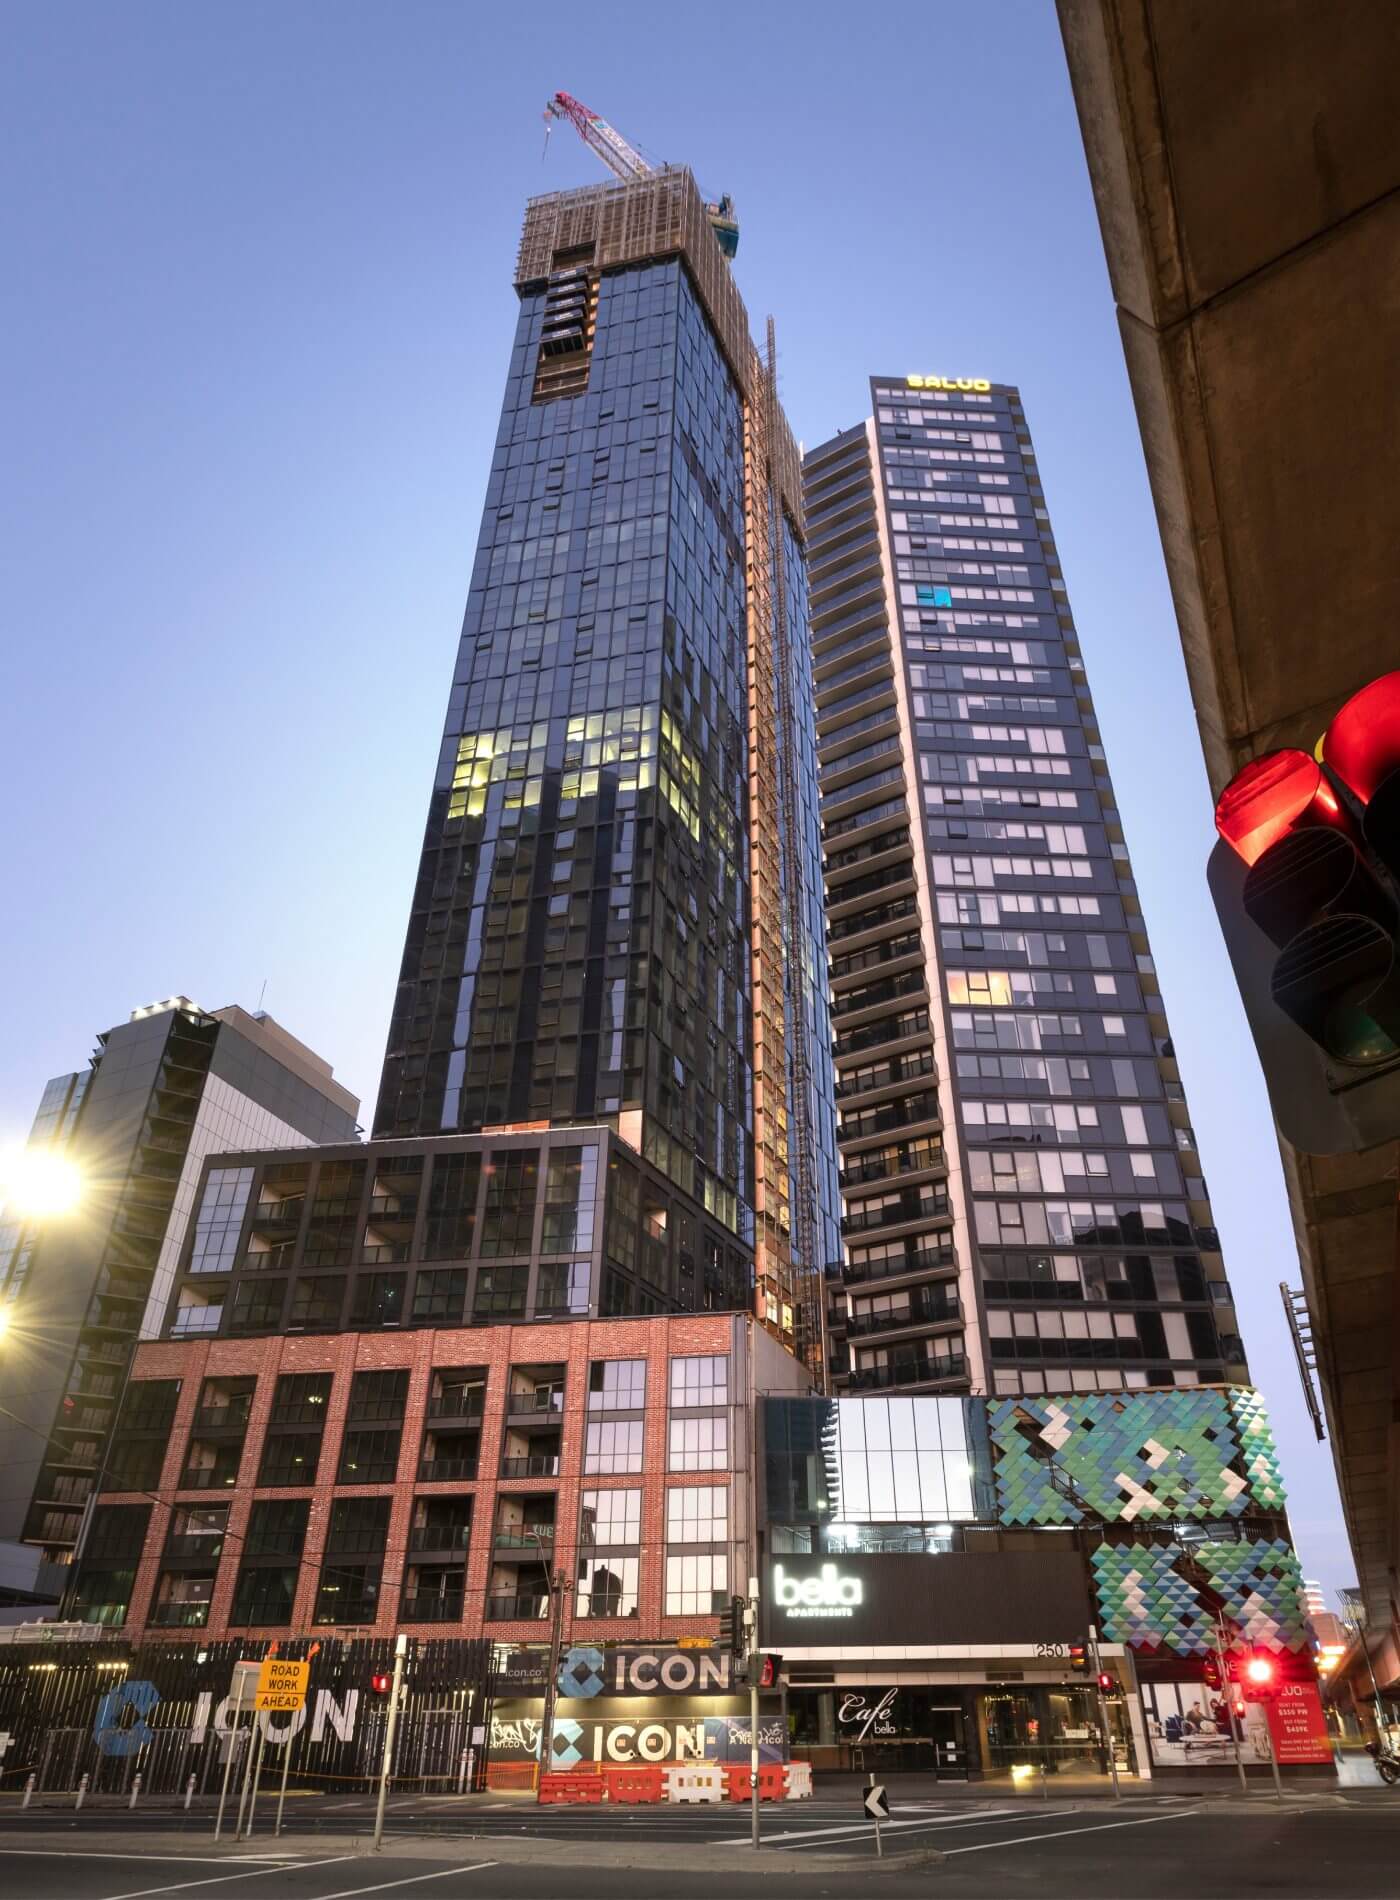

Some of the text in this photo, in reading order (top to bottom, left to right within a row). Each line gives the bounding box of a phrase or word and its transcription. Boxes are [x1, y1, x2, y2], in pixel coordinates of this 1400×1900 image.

[774, 1563, 862, 1606] bella
[786, 1607, 853, 1617] APARTMENTS
[1036, 1643, 1064, 1657] 250
[270, 1665, 300, 1677] ROAD
[615, 1654, 729, 1691] ICON
[268, 1679, 298, 1690] WORK
[261, 1695, 299, 1708] AHEAD
[838, 1687, 899, 1743] Café
[874, 1720, 896, 1734] bella
[593, 1724, 705, 1761] ICON
